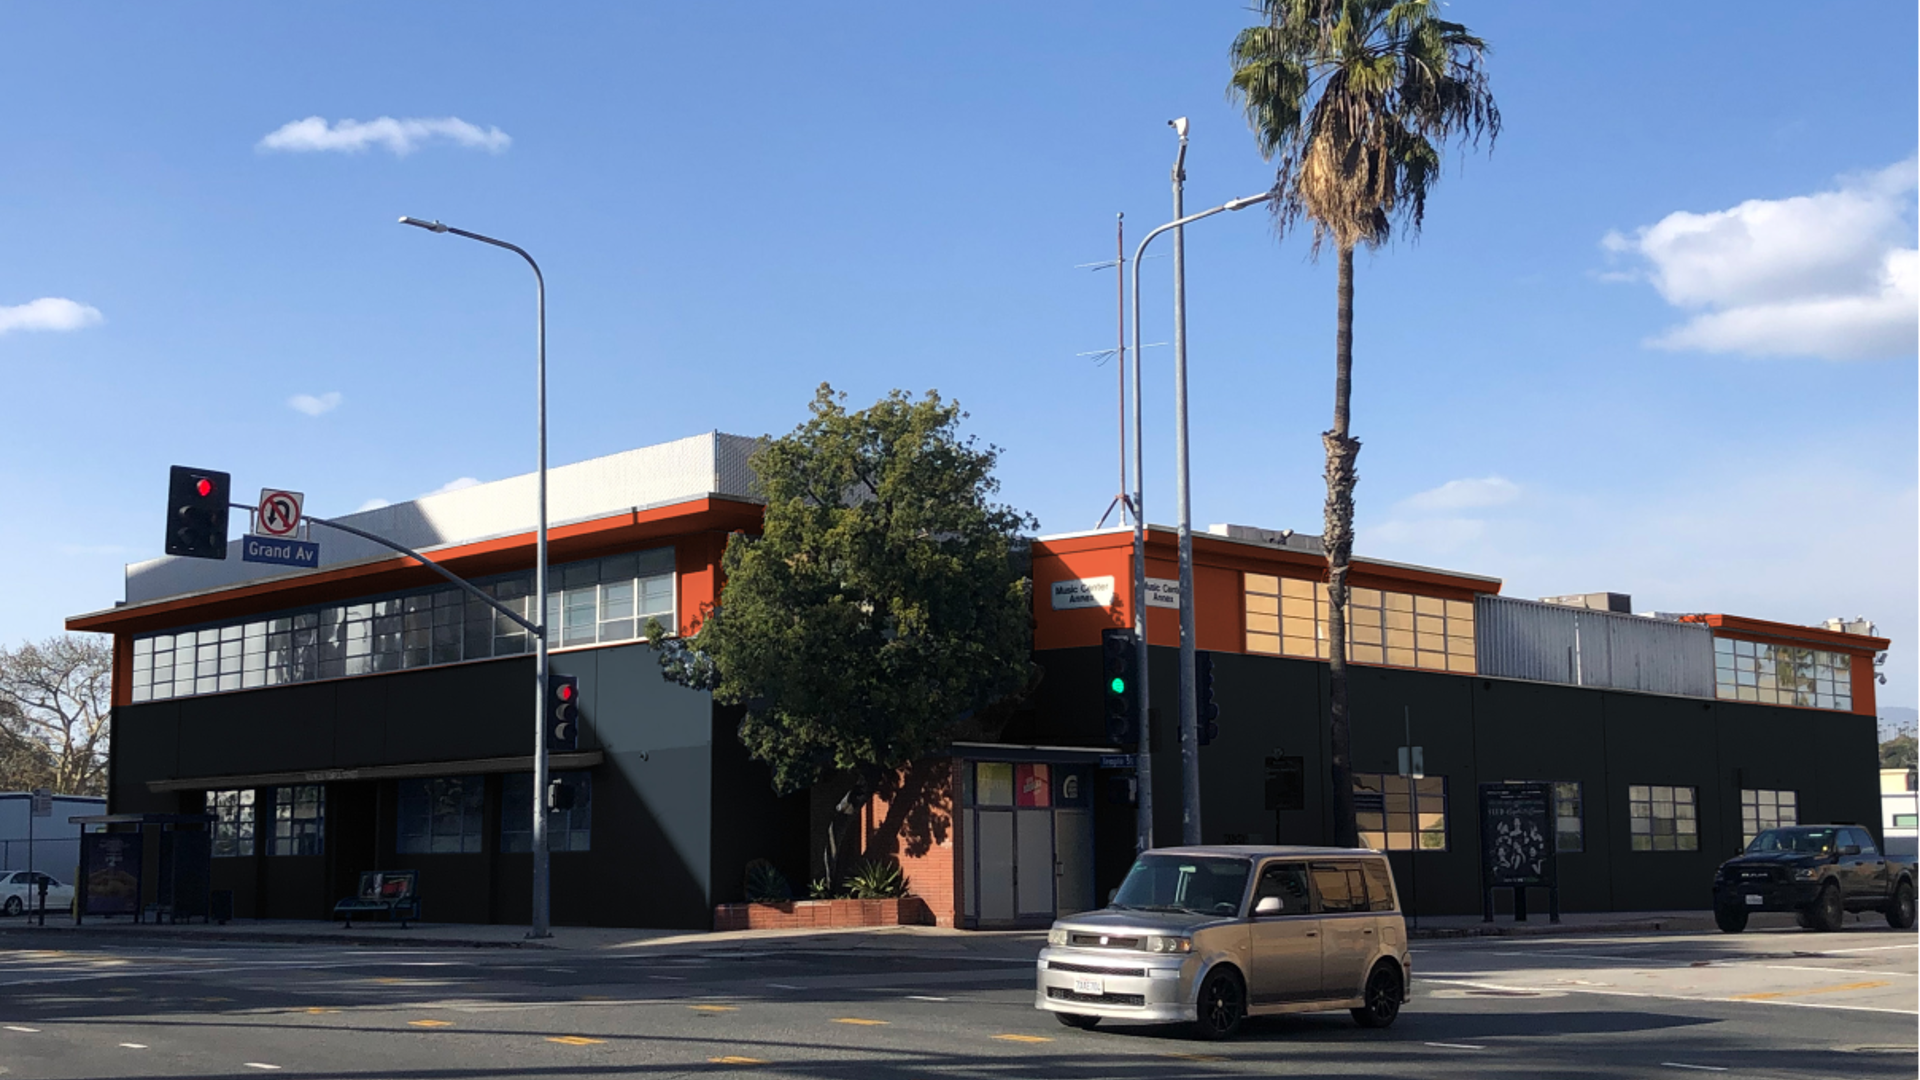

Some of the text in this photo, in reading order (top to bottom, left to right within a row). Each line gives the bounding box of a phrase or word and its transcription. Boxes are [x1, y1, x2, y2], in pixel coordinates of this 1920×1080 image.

[249, 541, 314, 562] Grand Av
[1055, 583, 1109, 595] Music Center
[1069, 594, 1094, 603] Annex
[1153, 592, 1174, 603] Annex
